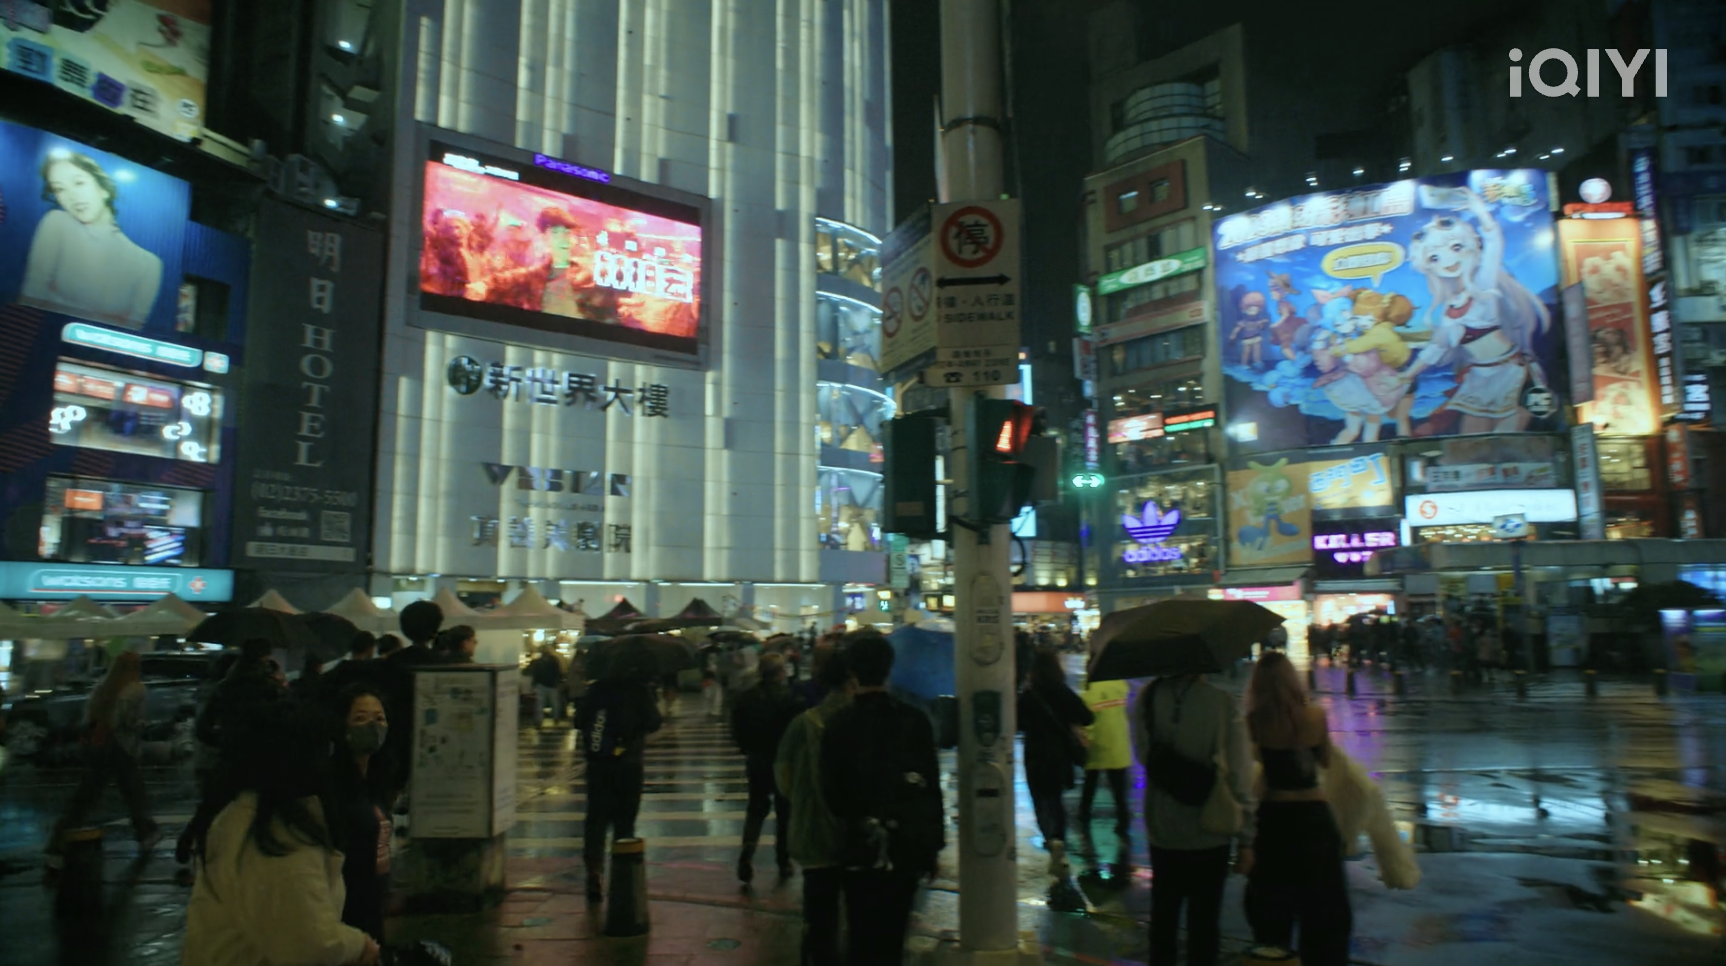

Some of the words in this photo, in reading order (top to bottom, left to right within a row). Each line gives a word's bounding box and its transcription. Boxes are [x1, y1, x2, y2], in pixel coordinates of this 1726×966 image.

[534, 153, 611, 184] Panasonic
[954, 220, 990, 255] 停
[293, 322, 337, 468] HOTEL
[484, 361, 669, 419] 新世界大樓
[1123, 545, 1182, 563] adidas
